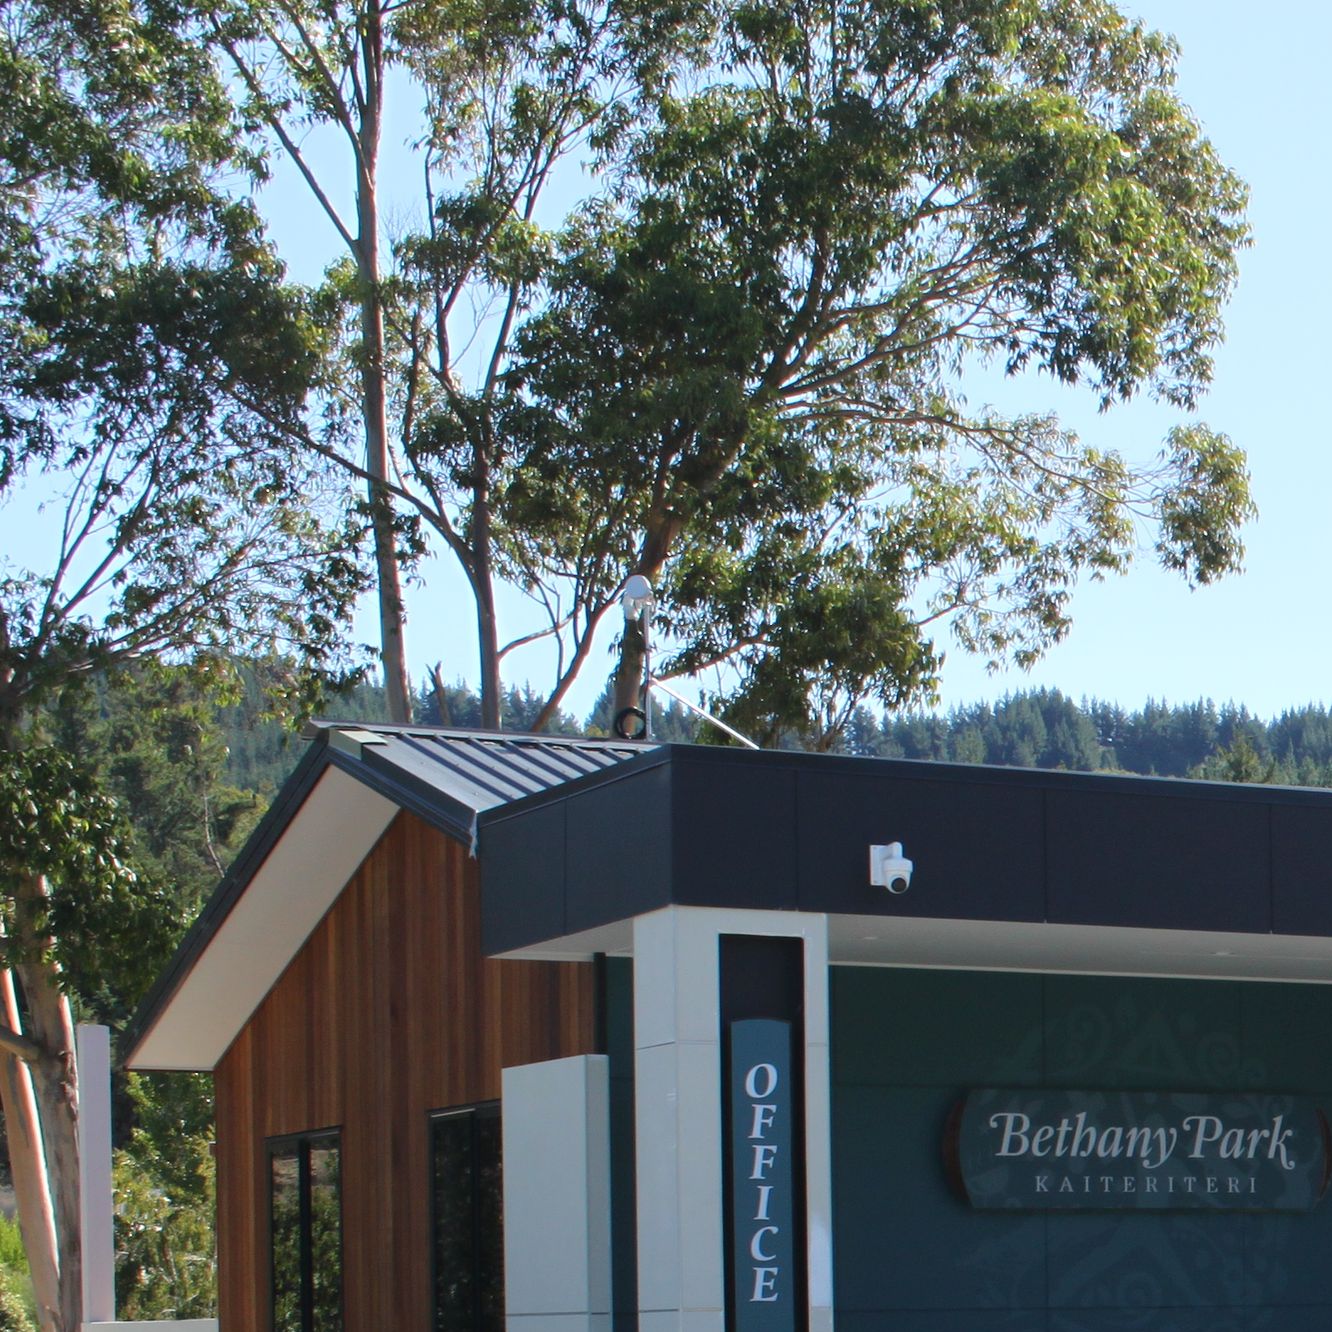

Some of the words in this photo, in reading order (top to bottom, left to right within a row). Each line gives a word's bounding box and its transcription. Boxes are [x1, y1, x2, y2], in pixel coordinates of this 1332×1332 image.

[988, 1111, 1178, 1168] Bethany
[1182, 1115, 1296, 1170] Park
[744, 1063, 779, 1303] OFFICE
[1035, 1175, 1258, 1194] KAITERITERI
